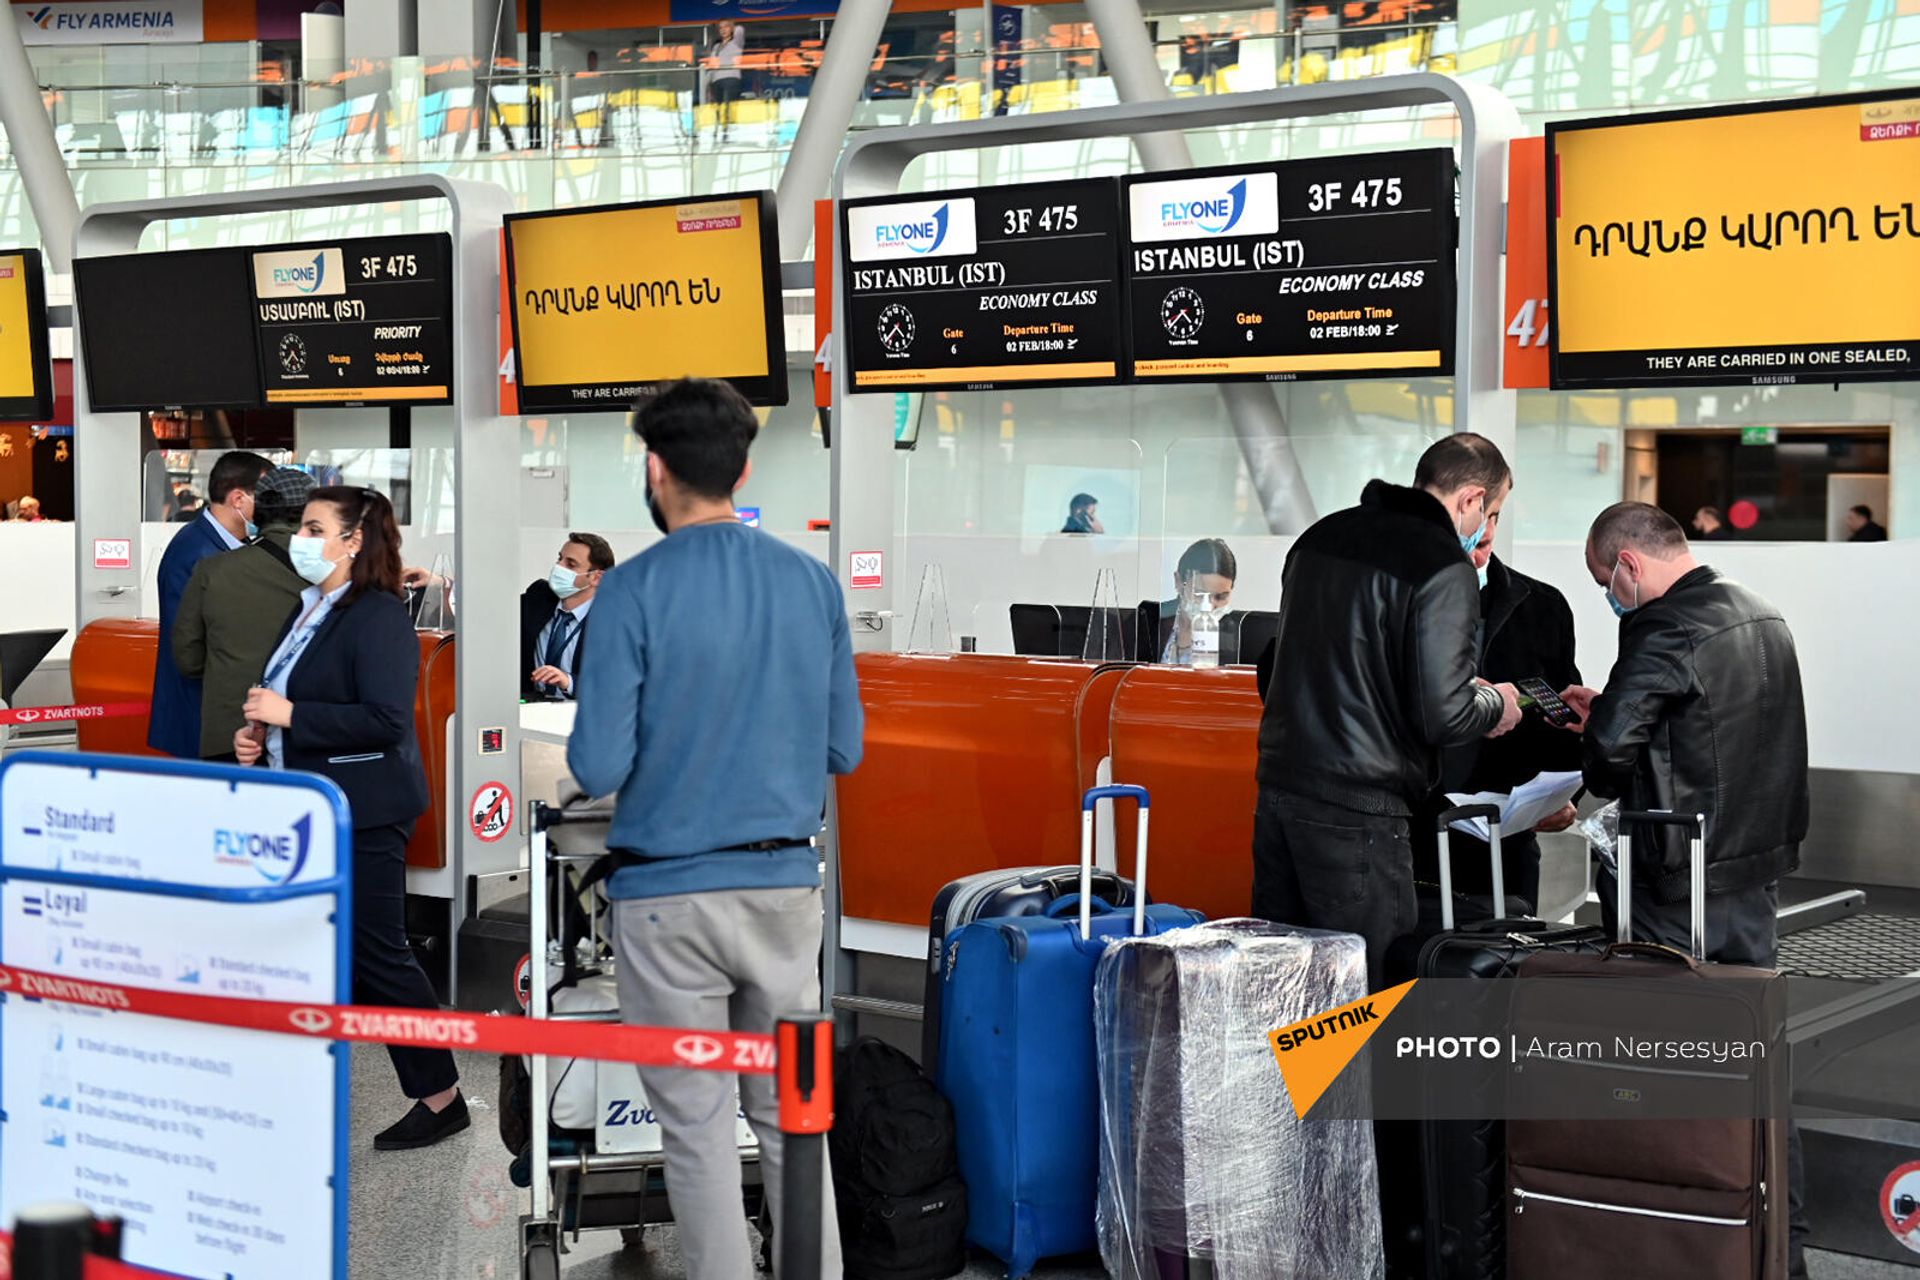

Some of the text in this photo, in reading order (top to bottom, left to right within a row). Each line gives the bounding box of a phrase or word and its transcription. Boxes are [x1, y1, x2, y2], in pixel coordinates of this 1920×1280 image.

[57, 12, 173, 29] FLY ARMENIA
[1308, 178, 1402, 212] 3F 475
[1003, 205, 1078, 234] 3F 475
[1161, 199, 1228, 221] FLYONE
[876, 222, 934, 242] FLYONE
[1134, 240, 1304, 272] ISTANBUL (IST)
[274, 266, 315, 282] FLYONE
[361, 255, 418, 278] 3F 475
[854, 261, 1006, 290] ISTANBUL (IST)
[1279, 270, 1424, 294] ECONOMY CLASS
[334, 300, 365, 321] (IST)
[979, 290, 1098, 311] ECONOMY CLASS
[1236, 313, 1262, 325] Gate
[1307, 306, 1393, 324] Departure Time
[374, 326, 422, 339] PRIORITY
[943, 327, 964, 339] Gate
[1003, 322, 1074, 337] Departure Time
[1310, 325, 1381, 339] 02 FEB/18:00
[951, 344, 957, 355] 6
[1006, 339, 1064, 352] 02 FEB/18:00
[1647, 357, 1682, 369] THEY
[1687, 355, 1717, 367] ARE
[1720, 353, 1786, 366] CARRIED
[1790, 352, 1804, 364] IN
[1808, 351, 1840, 364] ONE
[1752, 376, 1796, 384] SAMSUNG
[572, 389, 593, 399] THEY
[594, 388, 611, 398] ARE
[44, 706, 104, 719] ZVARTNOTS
[45, 806, 115, 834] Standard
[213, 828, 291, 861] FLYONE
[45, 888, 87, 917] Loyal
[18, 972, 130, 1008] ZVARTNOTS
[341, 1011, 478, 1044] ZVARTNOTS
